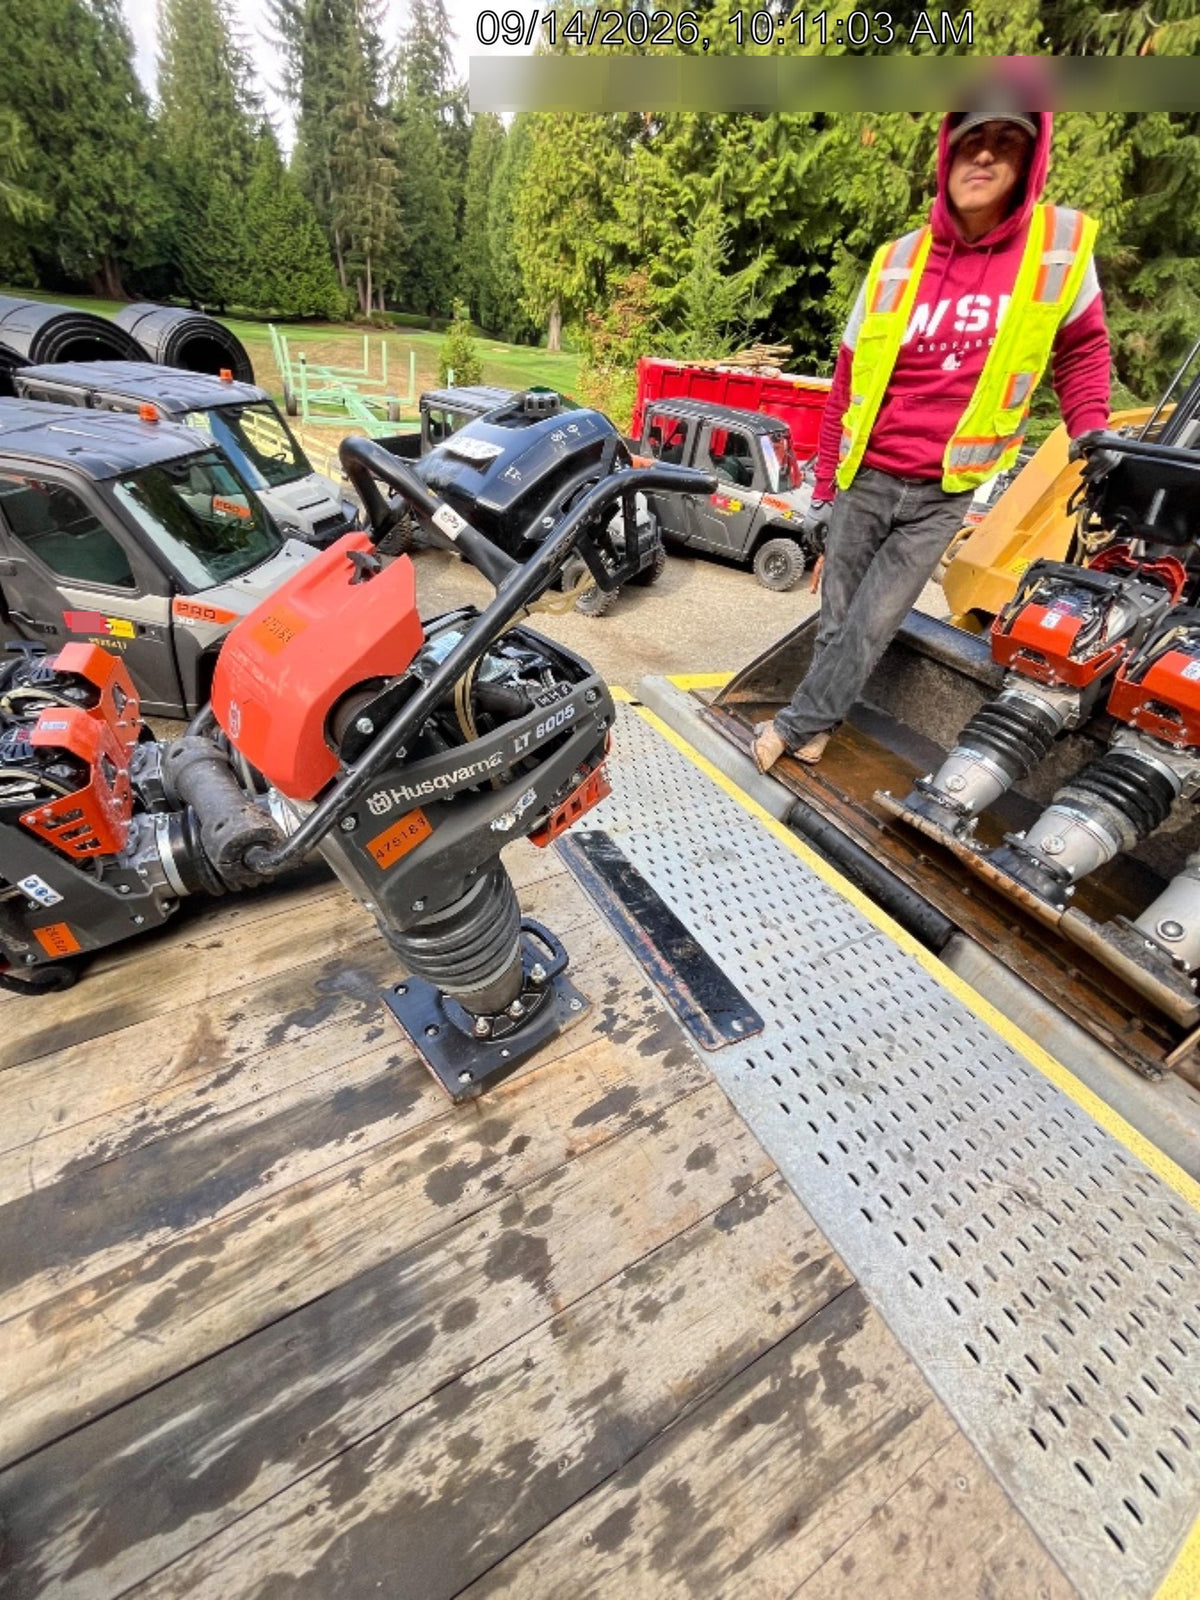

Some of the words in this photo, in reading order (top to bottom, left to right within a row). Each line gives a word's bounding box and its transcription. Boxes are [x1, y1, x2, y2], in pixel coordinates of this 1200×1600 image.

[177, 601, 216, 620] PRO
[389, 751, 504, 805] Husqvarna
[514, 736, 531, 754] LT
[375, 817, 428, 861] 475183
